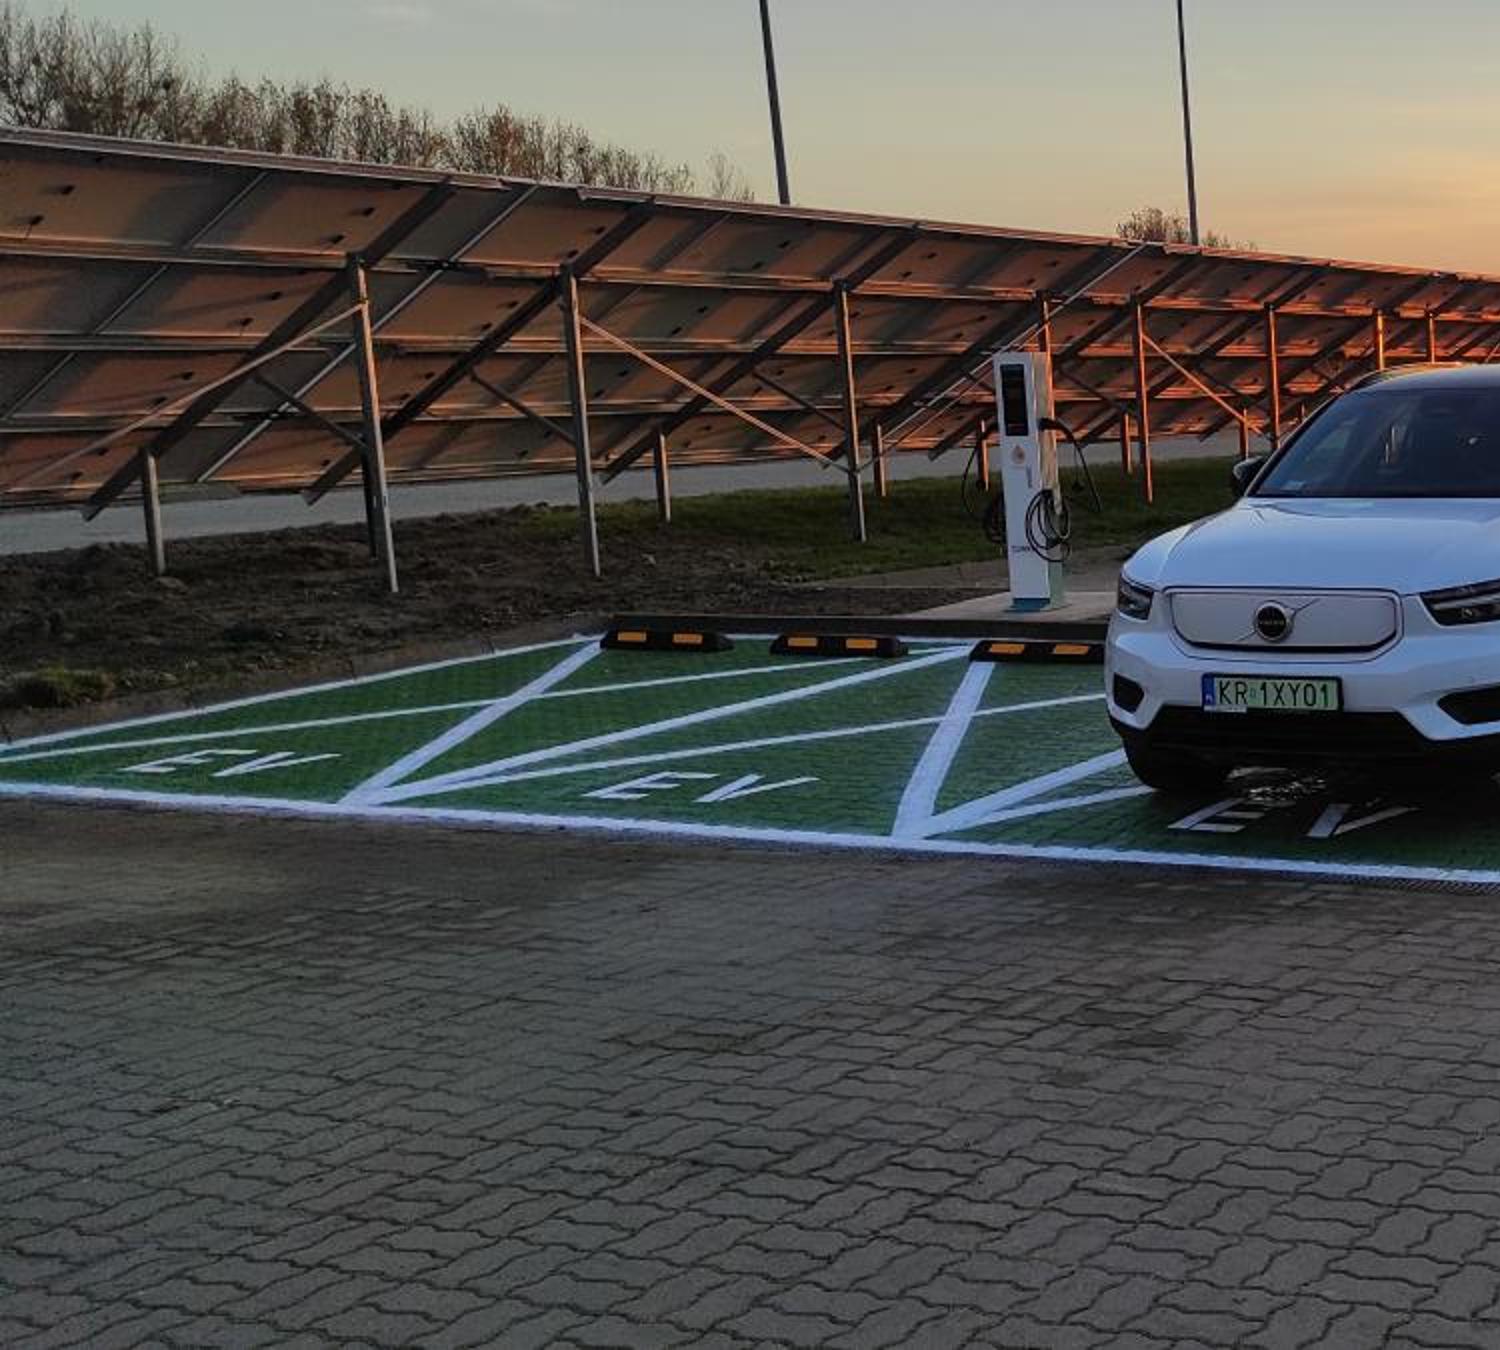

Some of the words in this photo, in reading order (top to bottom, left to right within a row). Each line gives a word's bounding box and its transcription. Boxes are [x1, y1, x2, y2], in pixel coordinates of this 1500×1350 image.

[1219, 680, 1248, 705] KR
[1260, 681, 1329, 708] 1XY01
[116, 749, 341, 777] EV
[581, 771, 820, 802] EV
